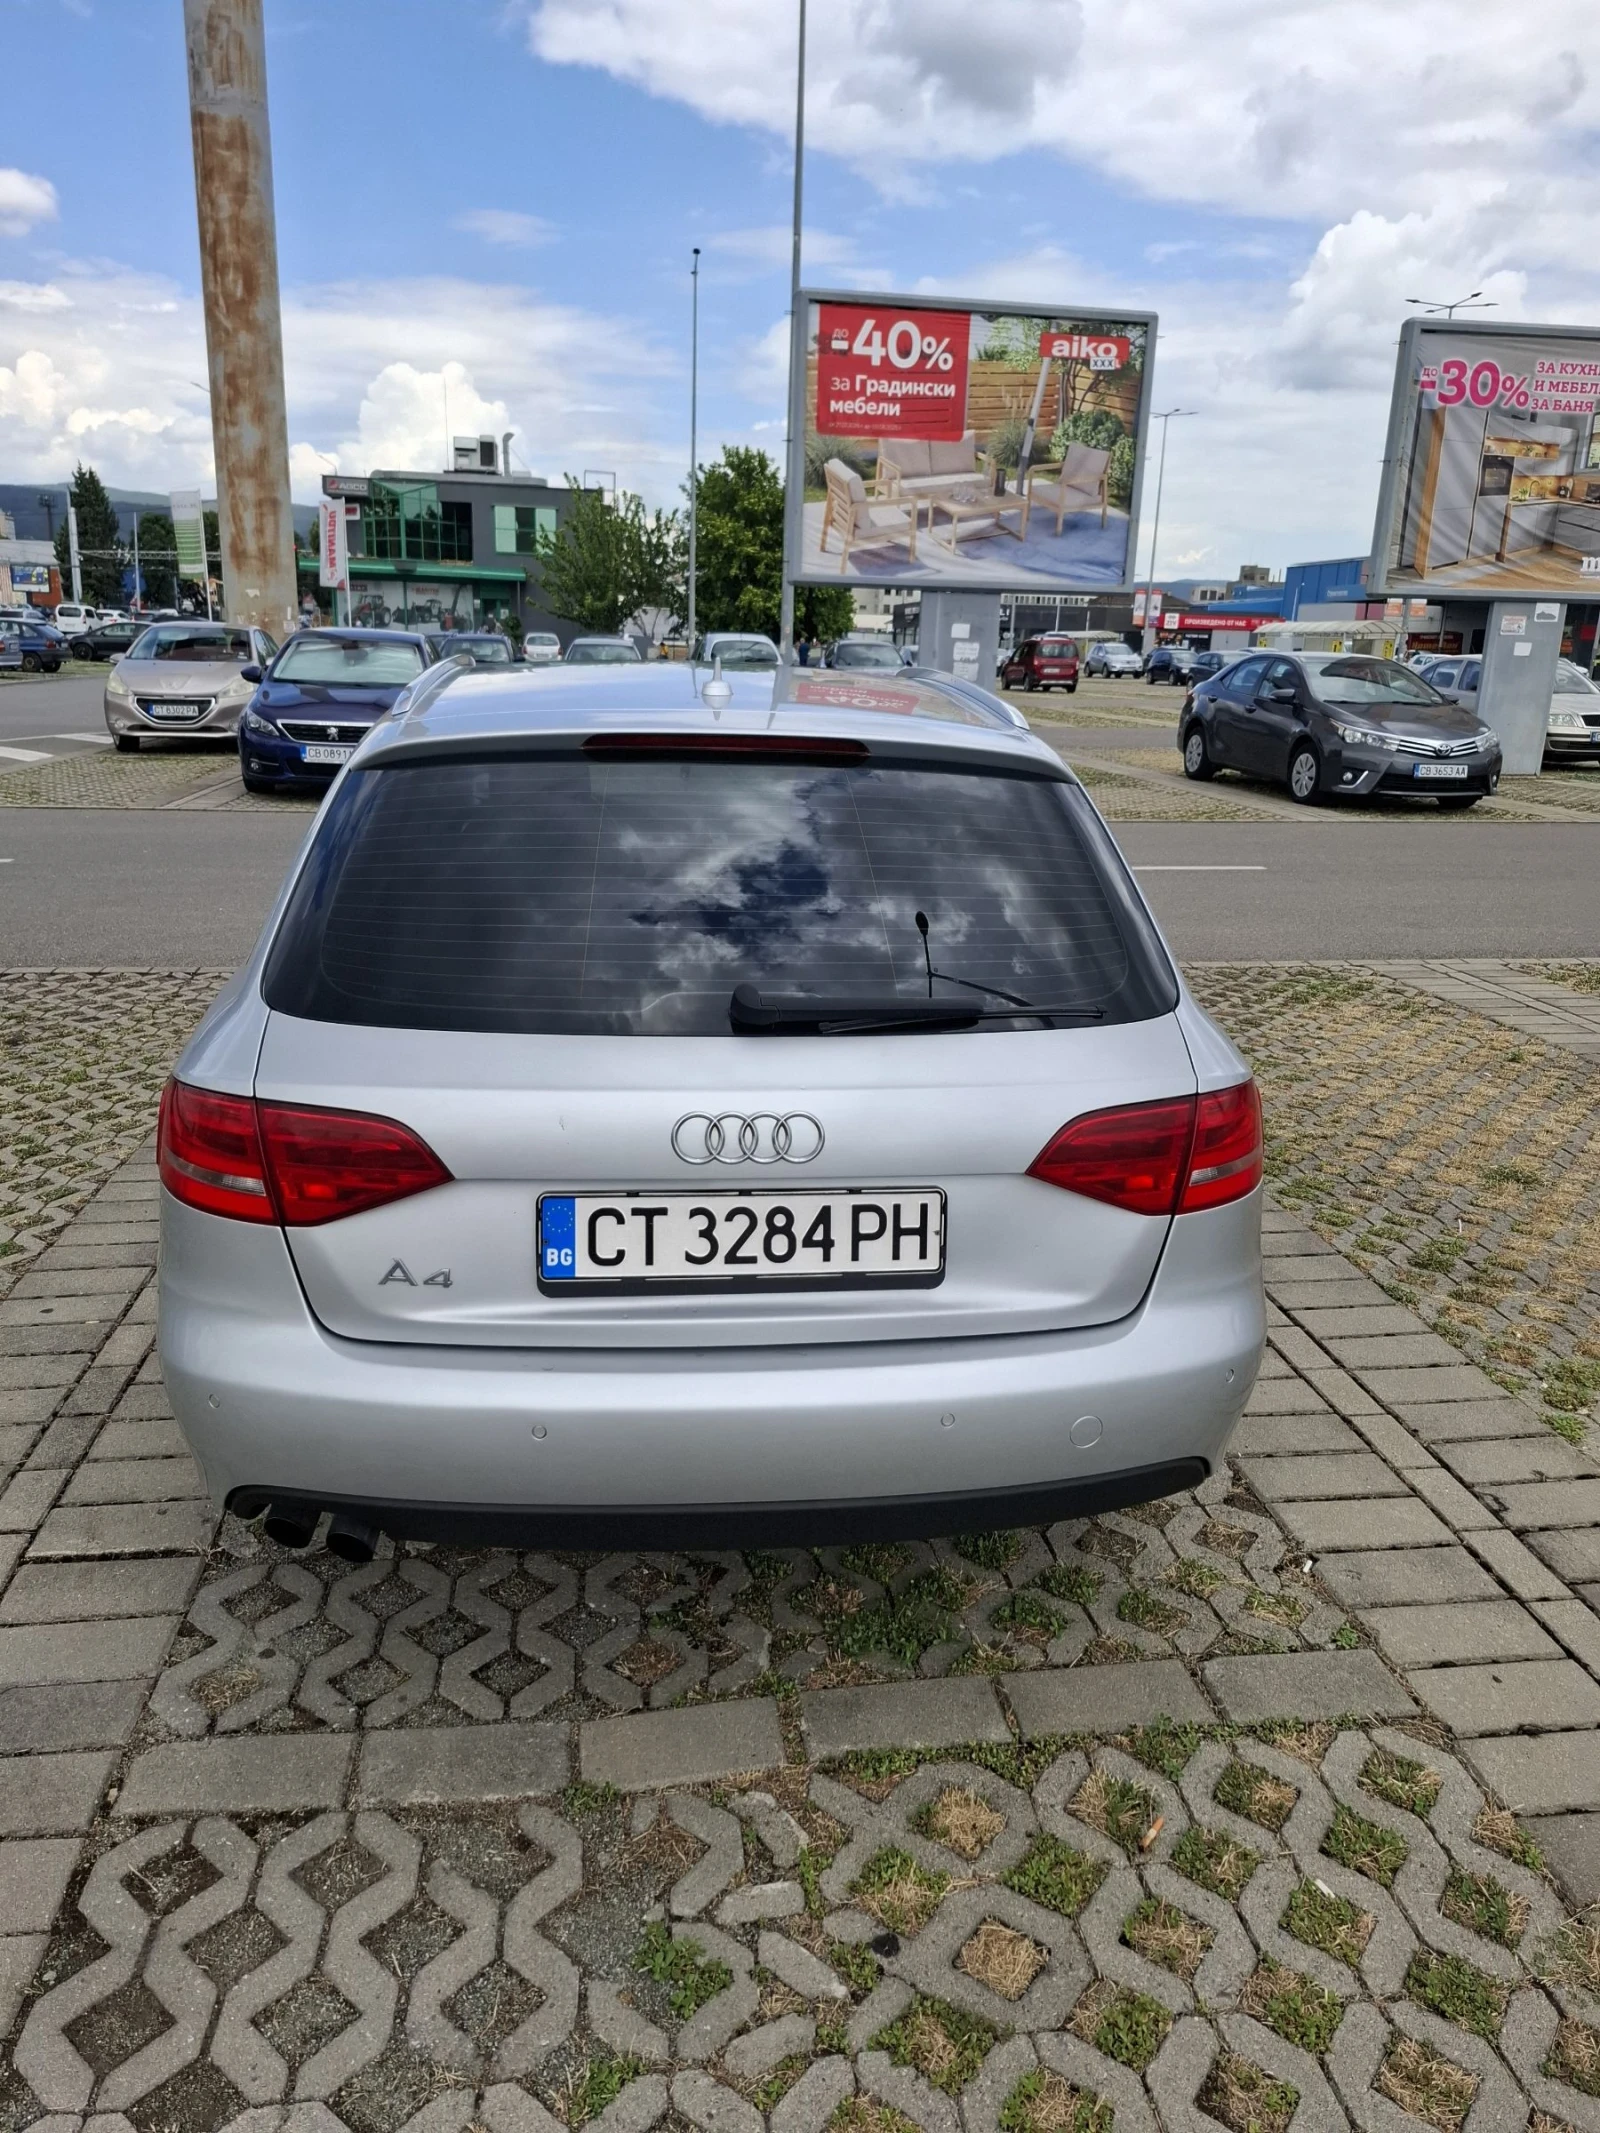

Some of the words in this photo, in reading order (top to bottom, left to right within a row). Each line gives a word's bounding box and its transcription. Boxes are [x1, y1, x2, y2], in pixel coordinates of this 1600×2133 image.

[831, 319, 954, 371] -40%
[1051, 335, 1118, 357] aiko
[1537, 361, 1556, 374] ЗА
[1559, 362, 1600, 376] КУХН
[830, 377, 850, 391] за
[855, 375, 956, 398] Градински
[1420, 360, 1530, 407] -30%
[1534, 380, 1545, 391] И
[1548, 381, 1600, 394] МЕБЕЛ
[830, 397, 901, 417] мебели
[1531, 398, 1549, 410] ЗА
[1552, 399, 1594, 413] БАНЯ
[308, 748, 321, 758] CB
[323, 748, 347, 759] 0891
[1420, 766, 1431, 776] CB
[1432, 766, 1454, 776] 3653
[1455, 767, 1466, 777] AA
[587, 1206, 669, 1267] CT
[684, 1204, 835, 1265] 3284
[850, 1202, 929, 1262] PH
[547, 1248, 572, 1266] BG
